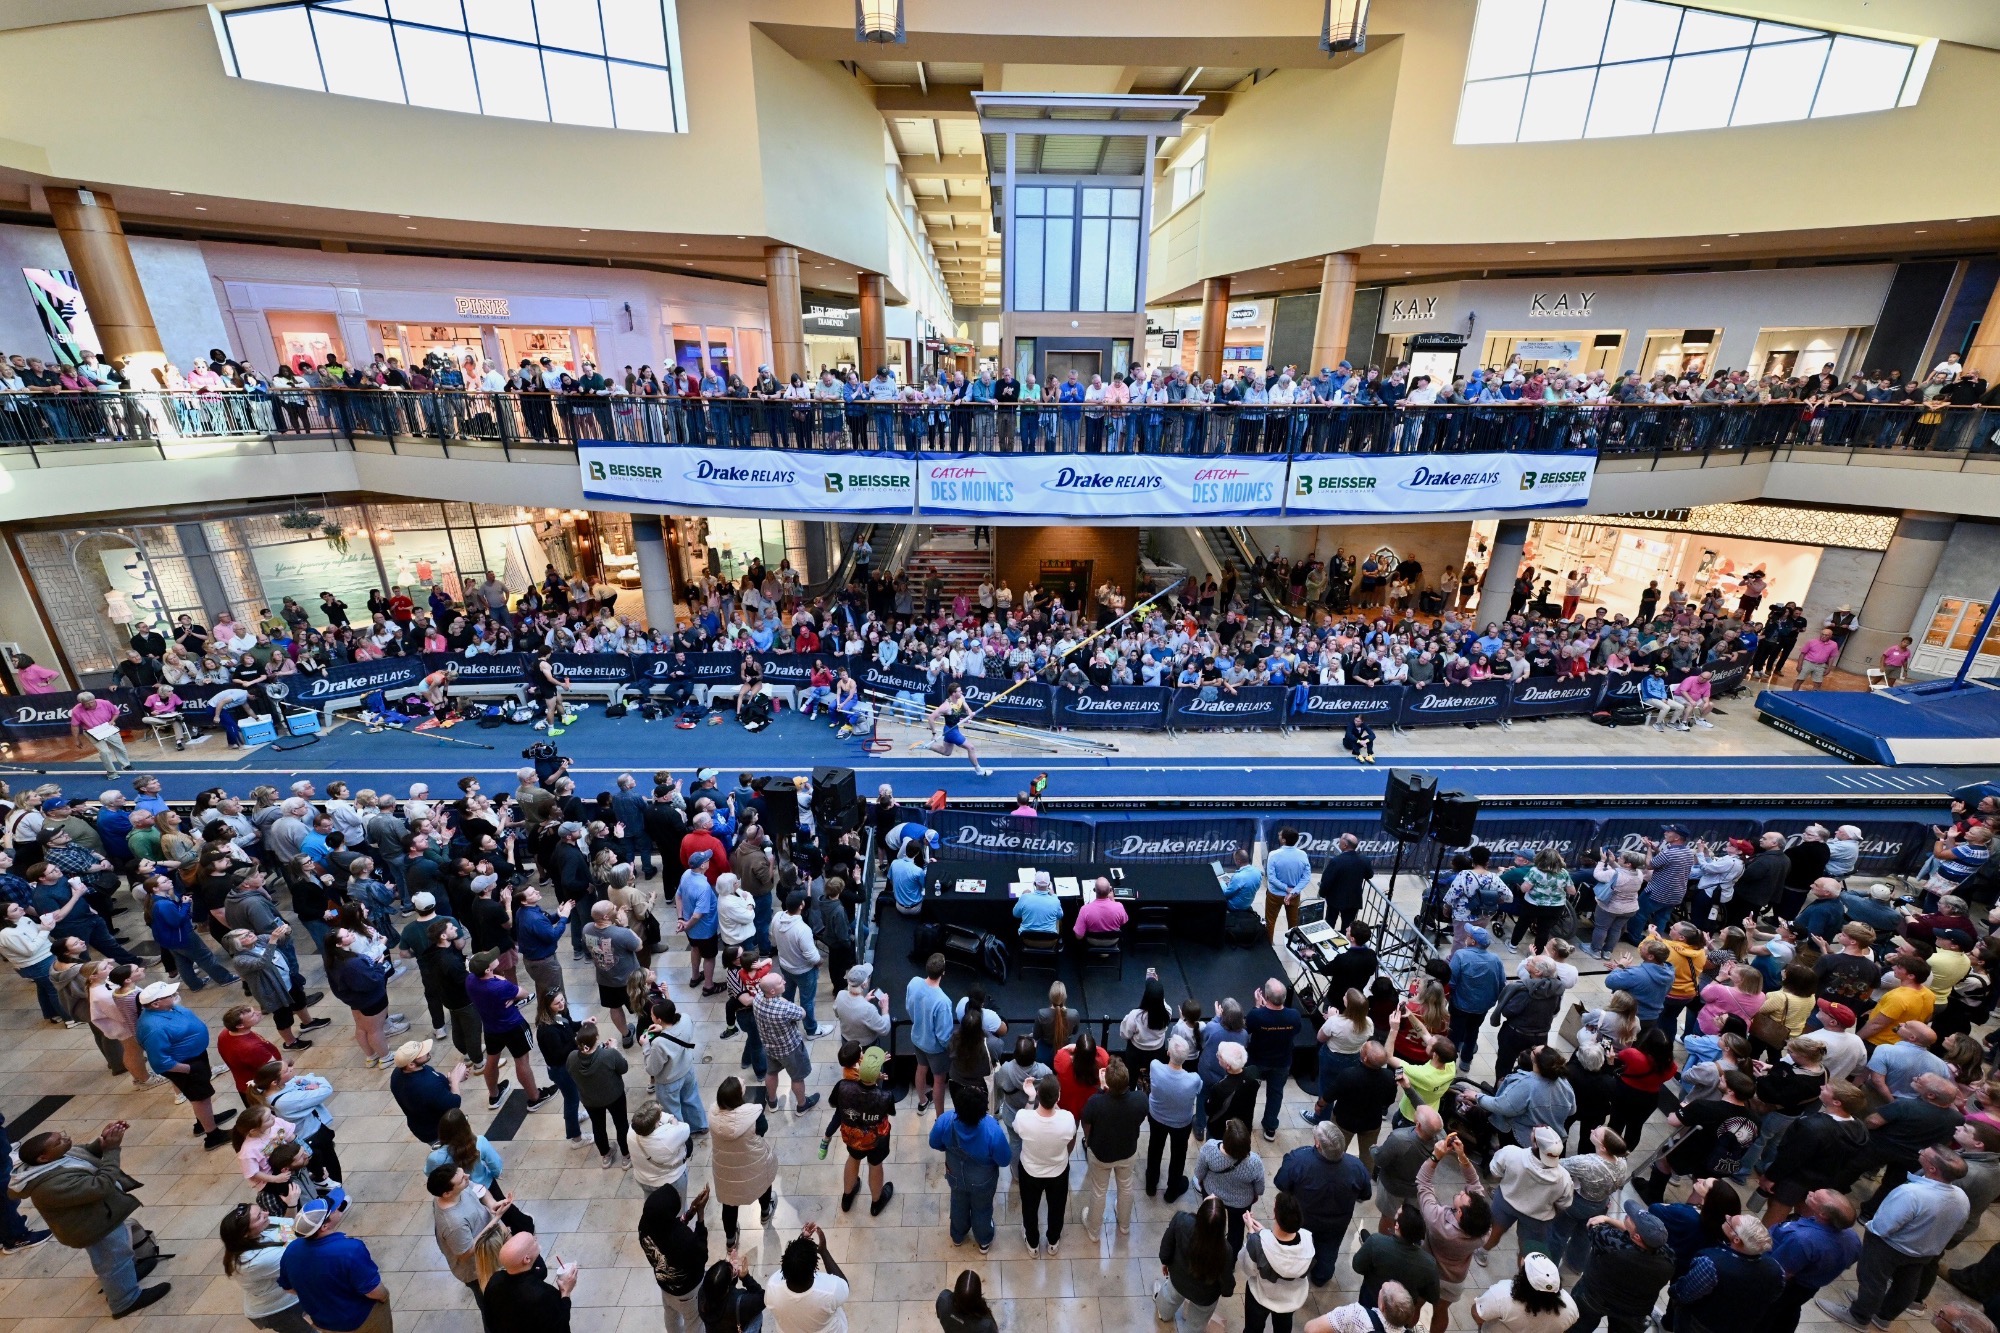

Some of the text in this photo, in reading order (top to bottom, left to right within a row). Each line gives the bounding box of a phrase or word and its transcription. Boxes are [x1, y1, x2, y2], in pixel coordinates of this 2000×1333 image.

[455, 297, 510, 316] PINK
[1392, 297, 1438, 316] KAY
[1531, 292, 1597, 311] KAY
[817, 317, 845, 327] DIAMONDS
[1391, 312, 1434, 321] JEWELERS
[1417, 336, 1463, 345] Jordan Creek
[609, 463, 662, 479] BEISSER
[696, 459, 795, 483] Drake RELAYS
[931, 466, 987, 479] CATCH
[1055, 467, 1162, 489] Drake RELAYS
[1194, 469, 1250, 481] CATCH
[1409, 466, 1500, 487] Drake RELAYS
[1540, 470, 1587, 484] BEISSER
[849, 474, 911, 488] BEISSER
[1318, 476, 1377, 489] BEISSER
[931, 481, 1014, 503] DES MOINES
[1192, 481, 1274, 503] DES MOINES
[446, 660, 521, 674] Drake RELAYS
[552, 662, 626, 677] Drake RELAYS
[698, 666, 732, 674] RELAYS
[764, 661, 803, 677] Drake
[310, 669, 410, 696] Drake RELAYS
[867, 668, 932, 693] Drake RELAYS
[1008, 695, 1044, 708] RELAYS
[1420, 694, 1496, 709] Drake RELAYS
[1521, 687, 1591, 701] Drake RELAYS
[1076, 695, 1161, 711] Drake RELAYS
[1188, 696, 1272, 712] Drake RELAYS
[1308, 695, 1388, 710] Drake RELAYS
[1773, 720, 1857, 761] BEISSER LUMBER
[956, 825, 1075, 854] Drake RELAYS
[1120, 835, 1238, 855] Drake RELAYS
[1292, 832, 1342, 853] Drak
[1518, 840, 1572, 852] RELAYS
[1858, 840, 1903, 854] ELAYS
